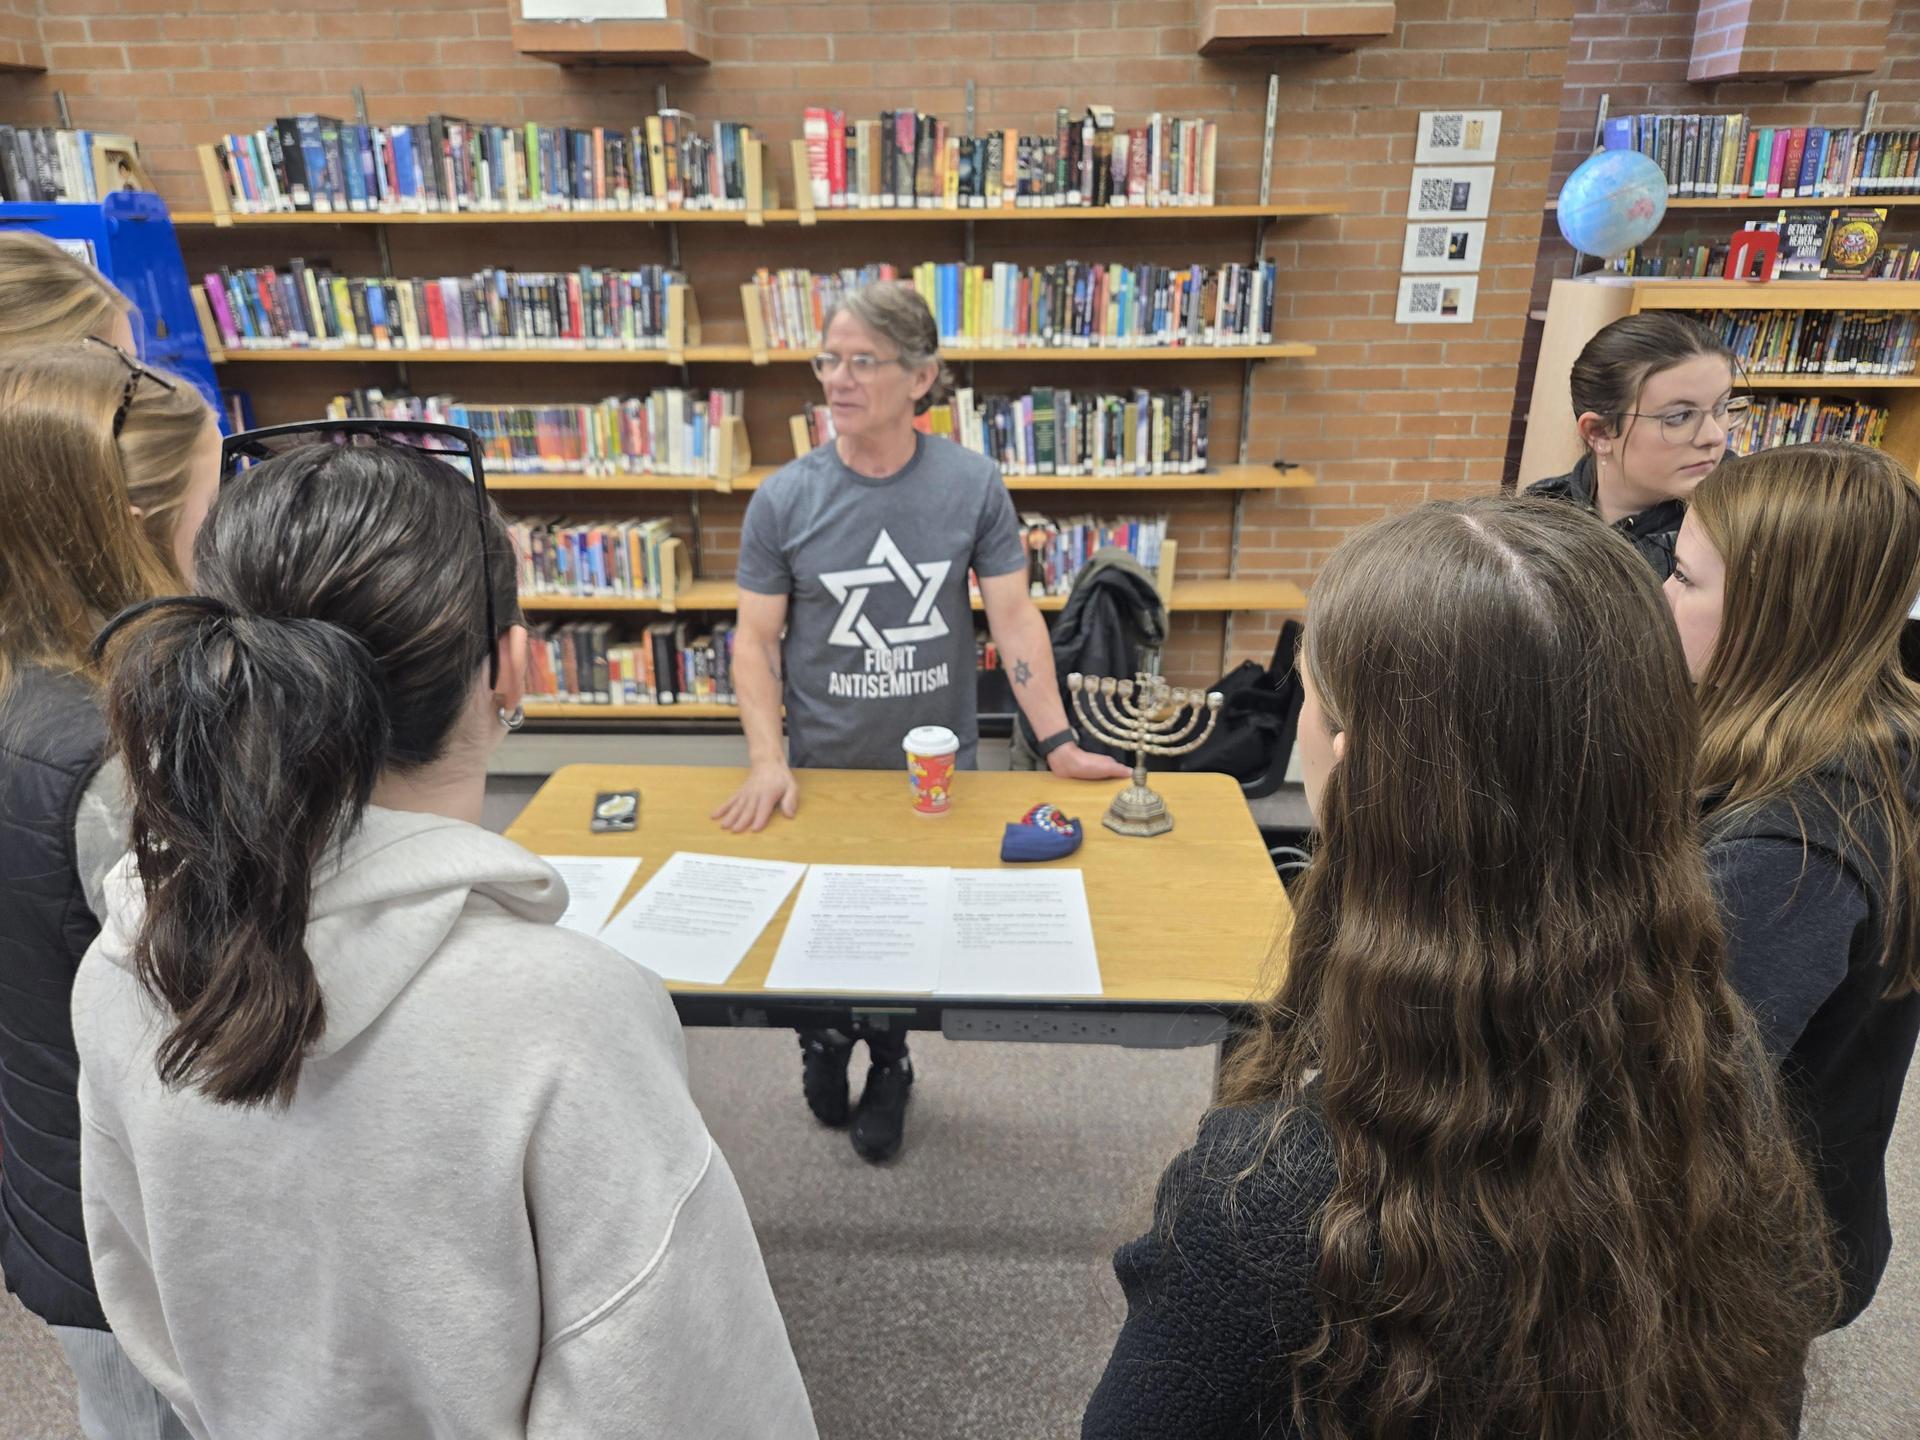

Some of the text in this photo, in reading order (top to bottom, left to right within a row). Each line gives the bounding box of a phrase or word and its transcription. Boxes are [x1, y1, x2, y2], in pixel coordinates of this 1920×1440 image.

[1787, 223, 1818, 236] BETWEEN
[1789, 235, 1813, 247] HEAVEN
[1796, 246, 1818, 257] EARTH
[863, 645, 917, 673] FIGHT
[827, 662, 949, 699] ANTISEMITISM
